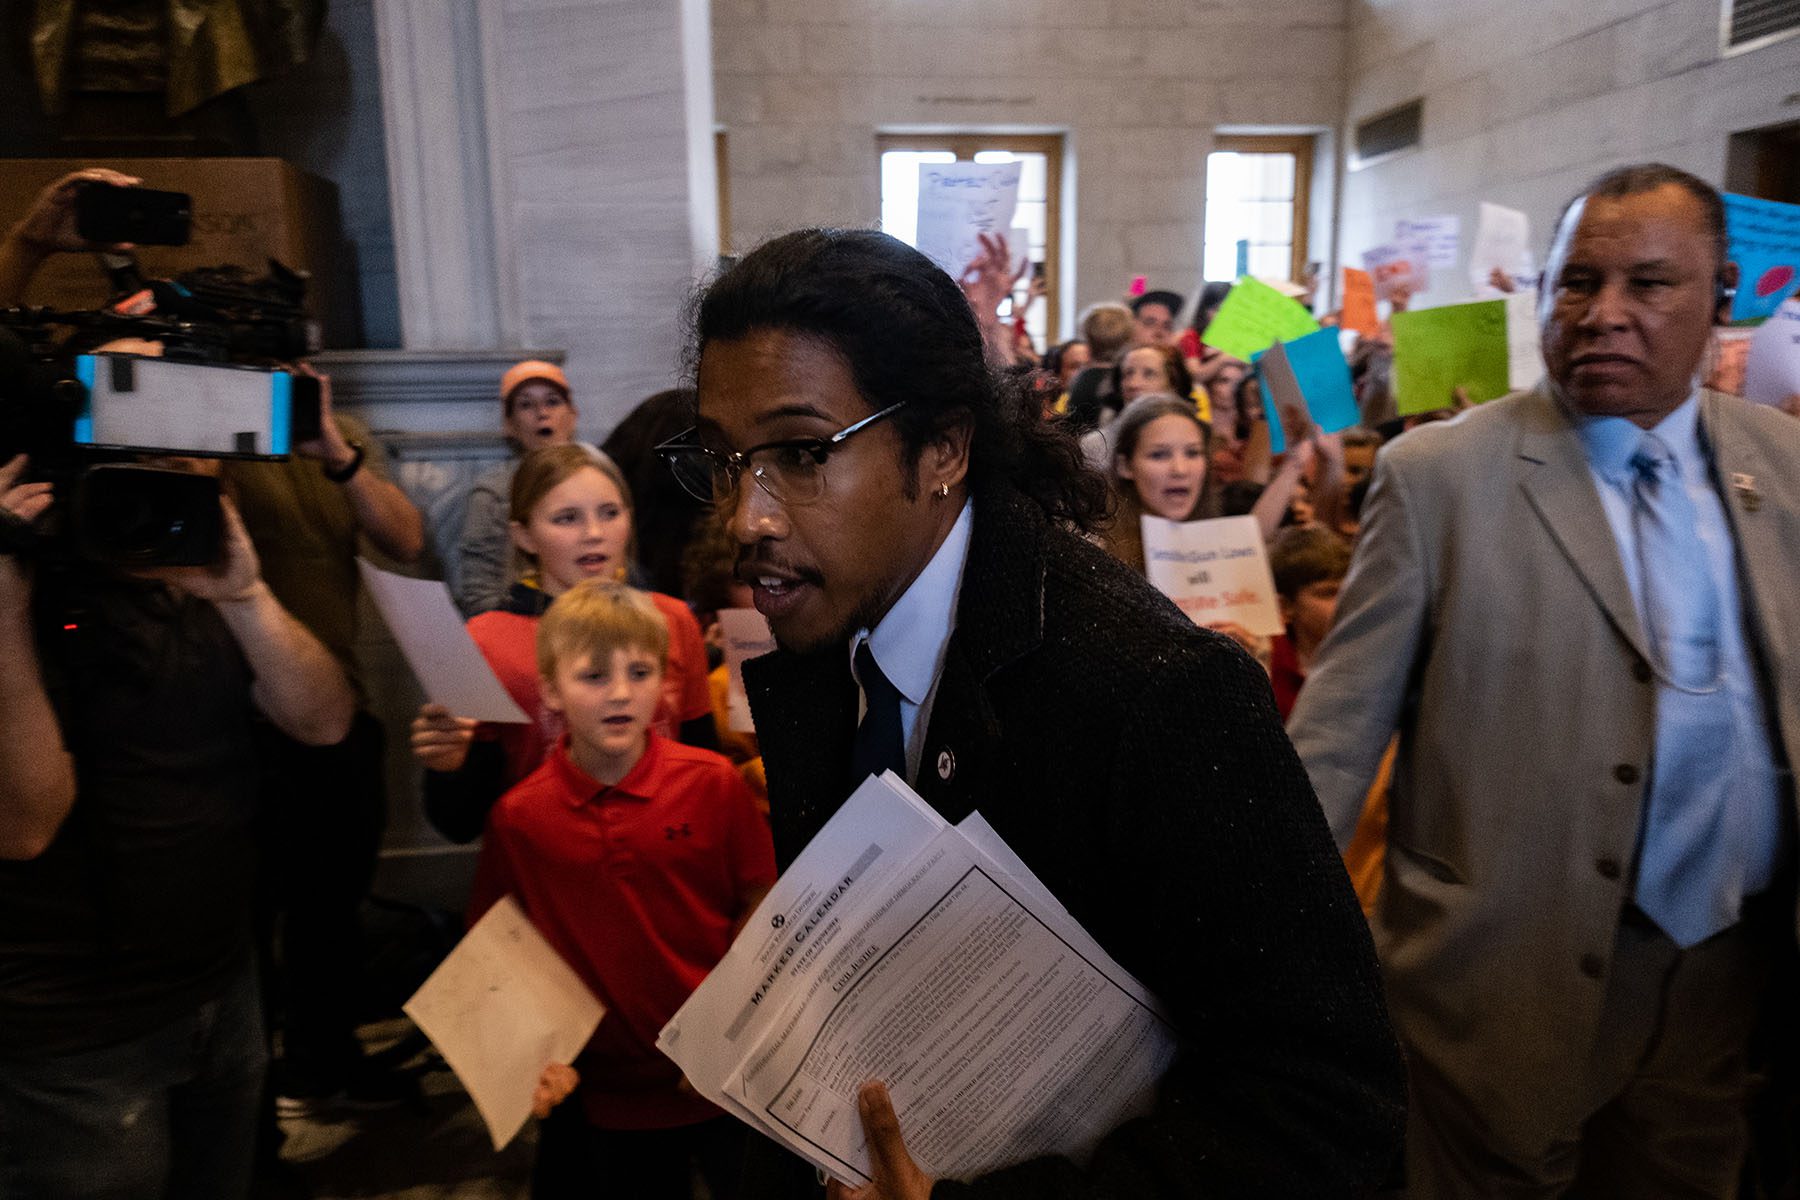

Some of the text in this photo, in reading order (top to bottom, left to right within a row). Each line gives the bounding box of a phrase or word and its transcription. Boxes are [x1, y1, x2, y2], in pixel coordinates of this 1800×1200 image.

[750, 874, 854, 1005] MARKED CALENDAR
[811, 916, 839, 948] TENNESSEE
[850, 942, 878, 971] JUSTICE
